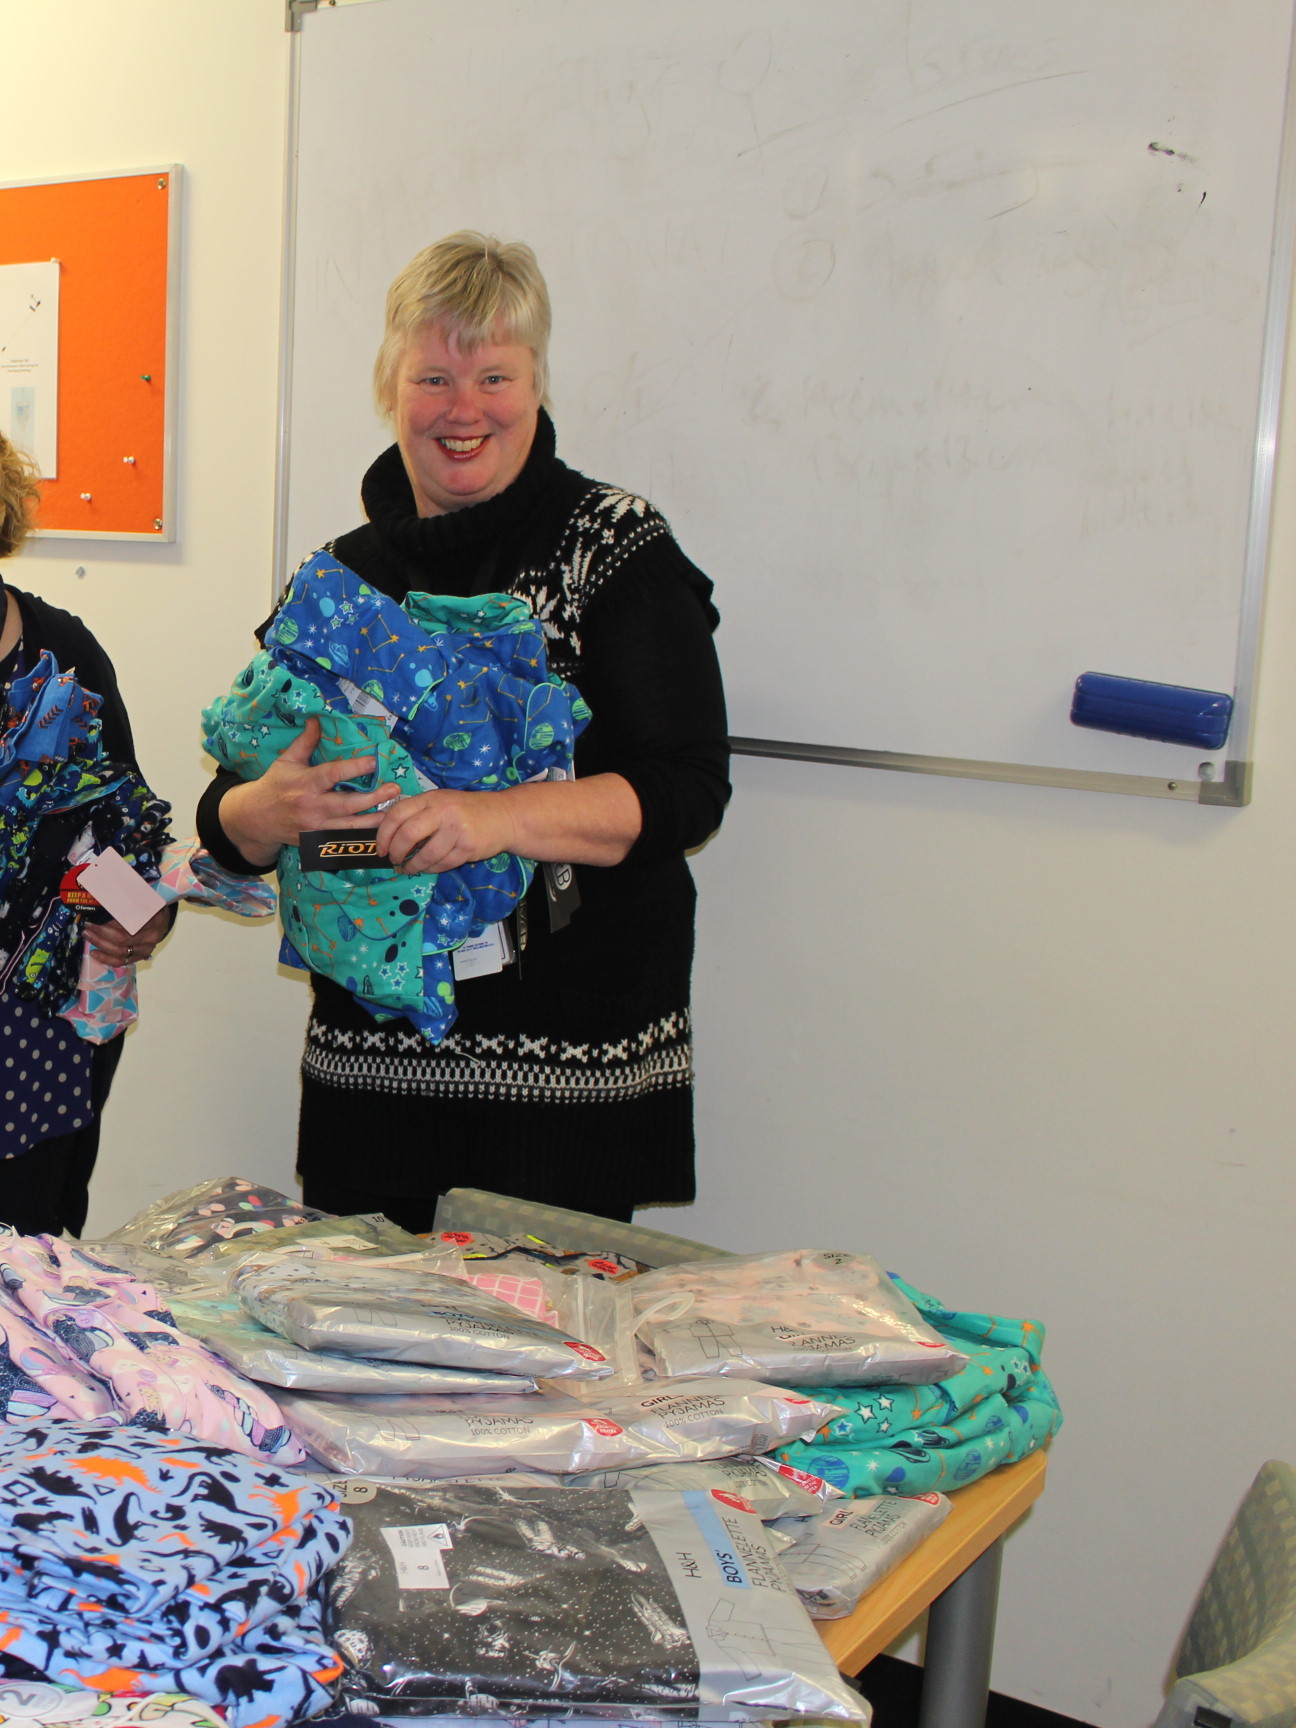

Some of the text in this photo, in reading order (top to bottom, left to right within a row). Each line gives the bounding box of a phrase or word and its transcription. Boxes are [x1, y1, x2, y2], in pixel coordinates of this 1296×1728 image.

[472, 1328, 509, 1339] COTTON
[658, 1397, 725, 1420] PYJAMAS
[665, 1408, 724, 1428] 100% COTTON
[465, 1415, 534, 1428] PYJAMAS
[470, 1426, 531, 1436] 100% COTTON
[353, 1486, 368, 1494] 8
[722, 1516, 768, 1588] FLANNELETTE
[675, 1552, 702, 1578] H&H
[715, 1549, 743, 1584] BOYS'
